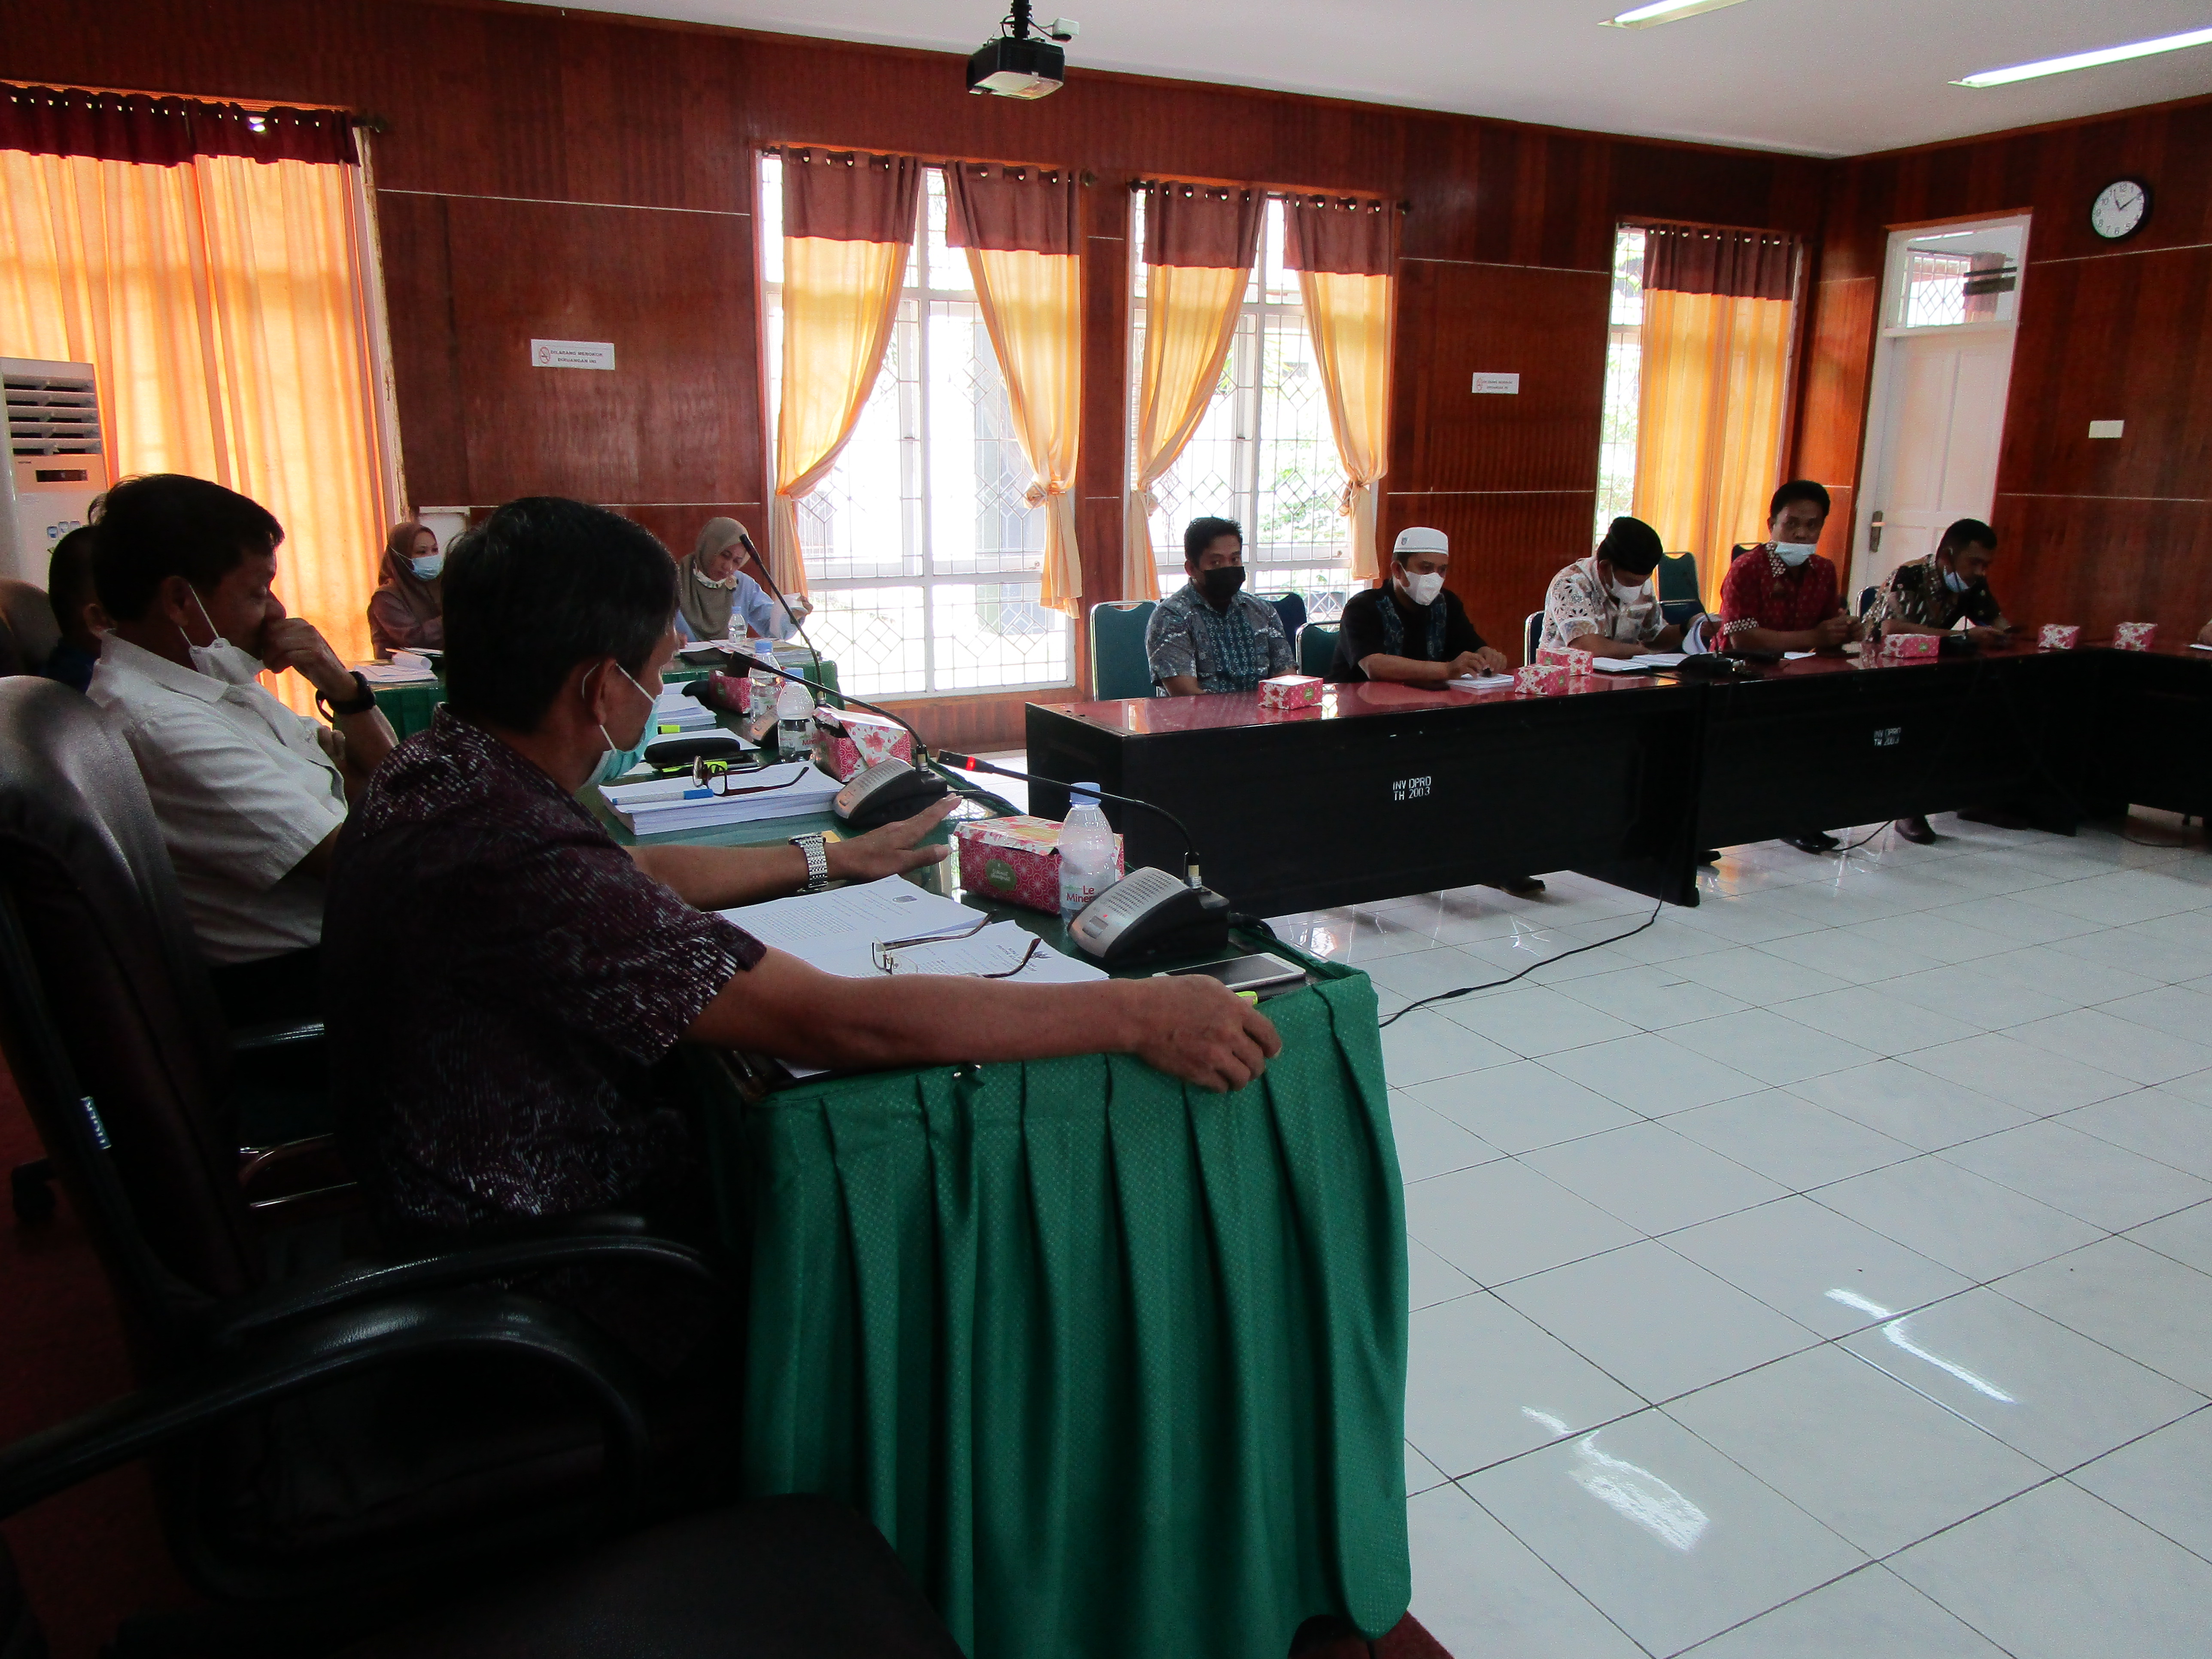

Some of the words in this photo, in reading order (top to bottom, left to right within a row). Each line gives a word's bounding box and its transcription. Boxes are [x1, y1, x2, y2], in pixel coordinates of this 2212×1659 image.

[1393, 780, 1406, 790] INV
[1409, 776, 1431, 789] DPRD
[1394, 791, 1404, 801] TH
[1408, 787, 1430, 799] 2003
[1083, 885, 1094, 895] Le
[1066, 893, 1095, 903] Miner
